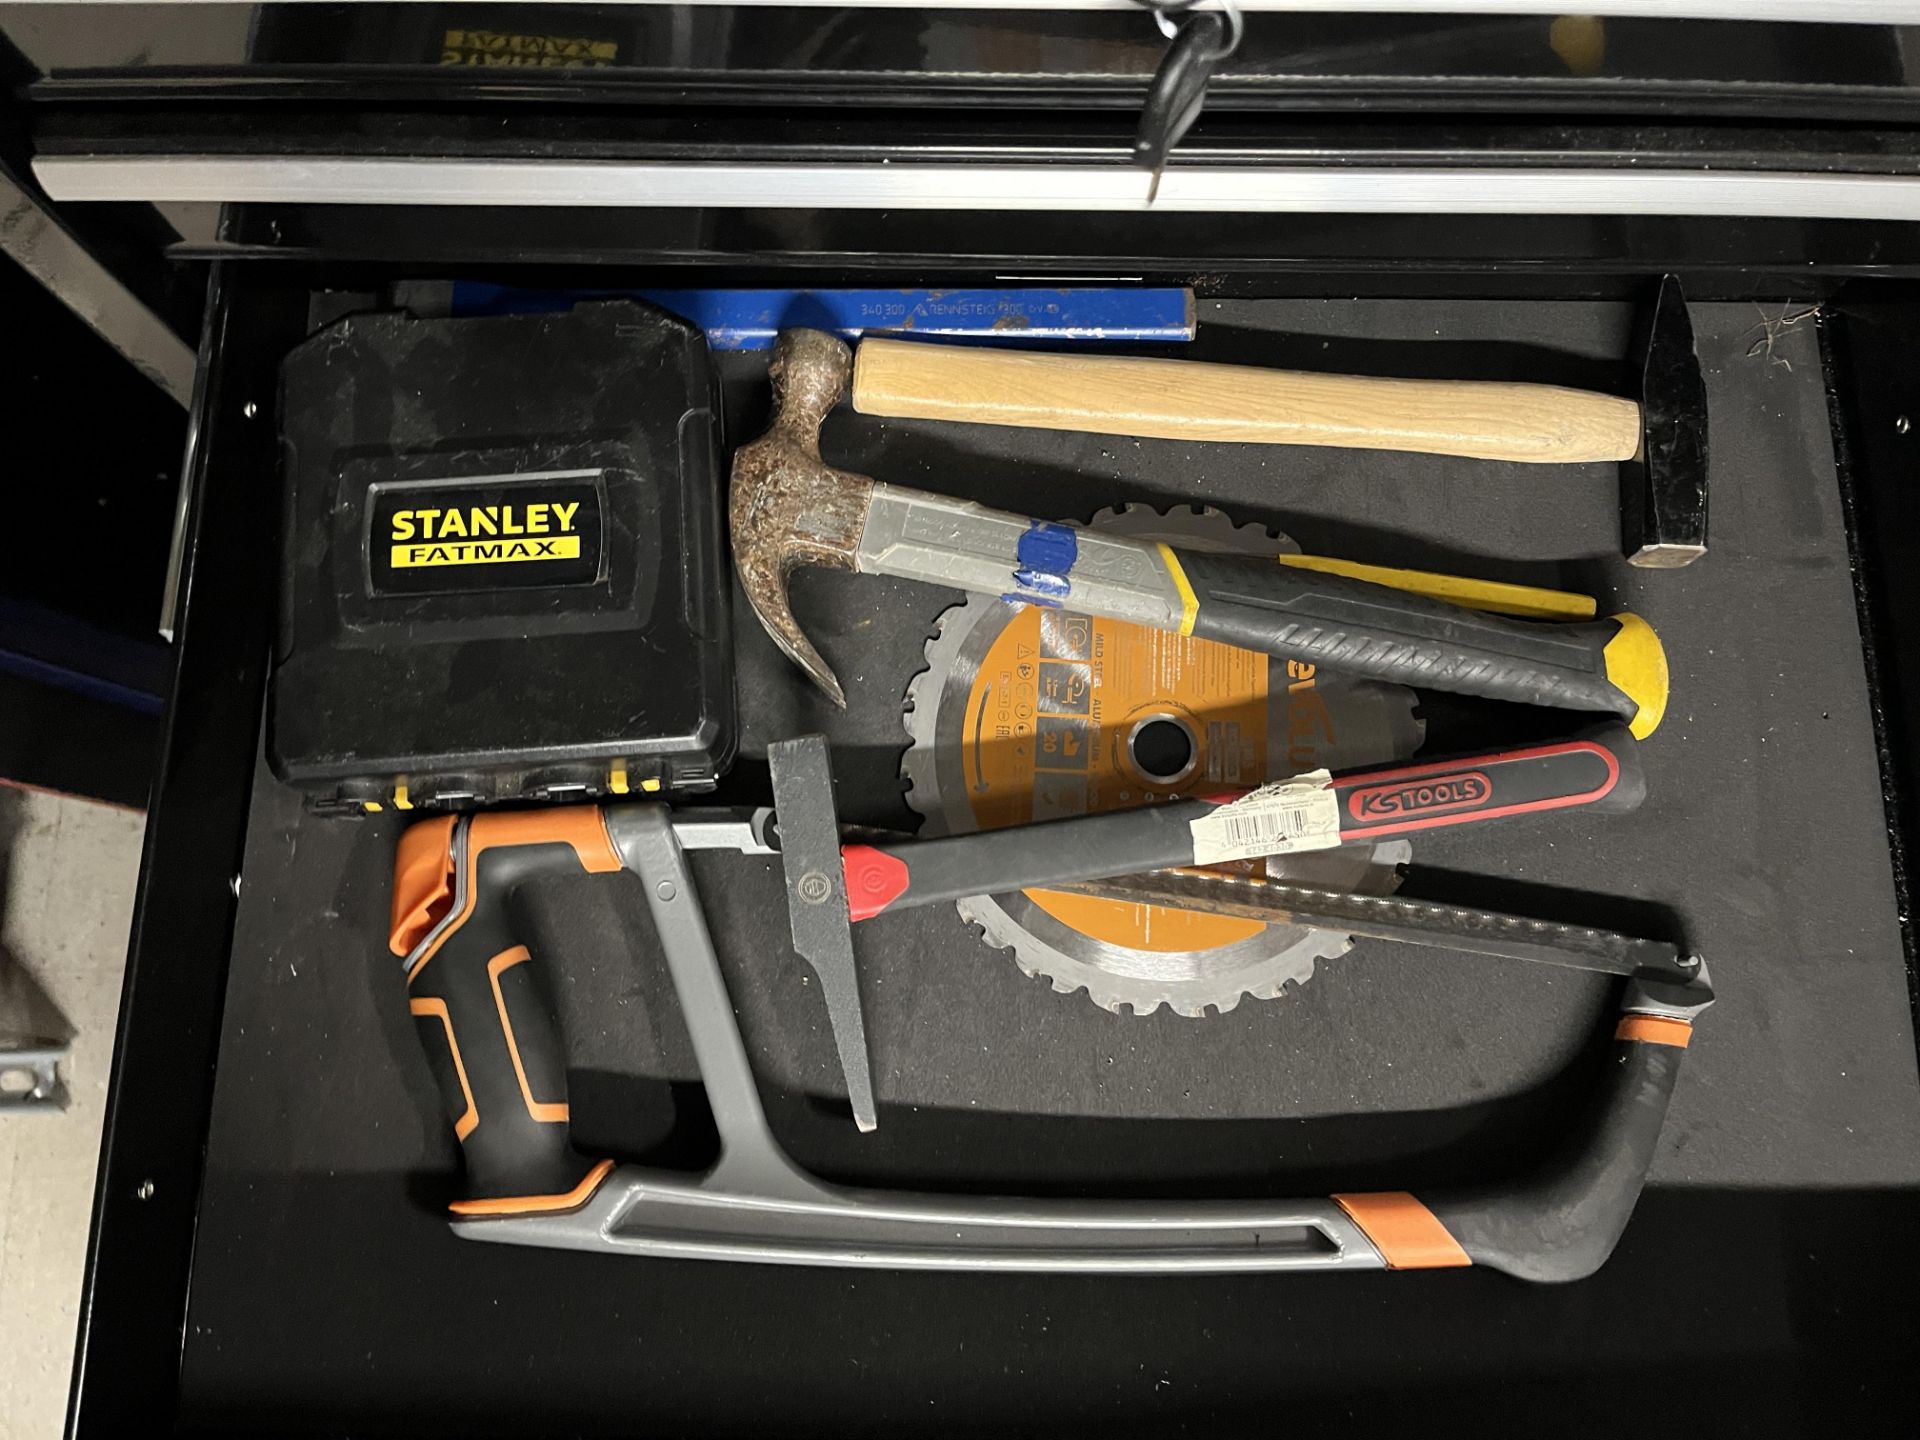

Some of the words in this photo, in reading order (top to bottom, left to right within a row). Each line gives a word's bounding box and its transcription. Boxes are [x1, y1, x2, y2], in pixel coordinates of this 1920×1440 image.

[391, 502, 580, 541] STANLEY
[409, 541, 557, 562] FATMAX
[1096, 632, 1105, 658] MILD
[1042, 731, 1057, 753] 20
[1360, 790, 1402, 816] KS
[1403, 779, 1478, 808] TOOLS
